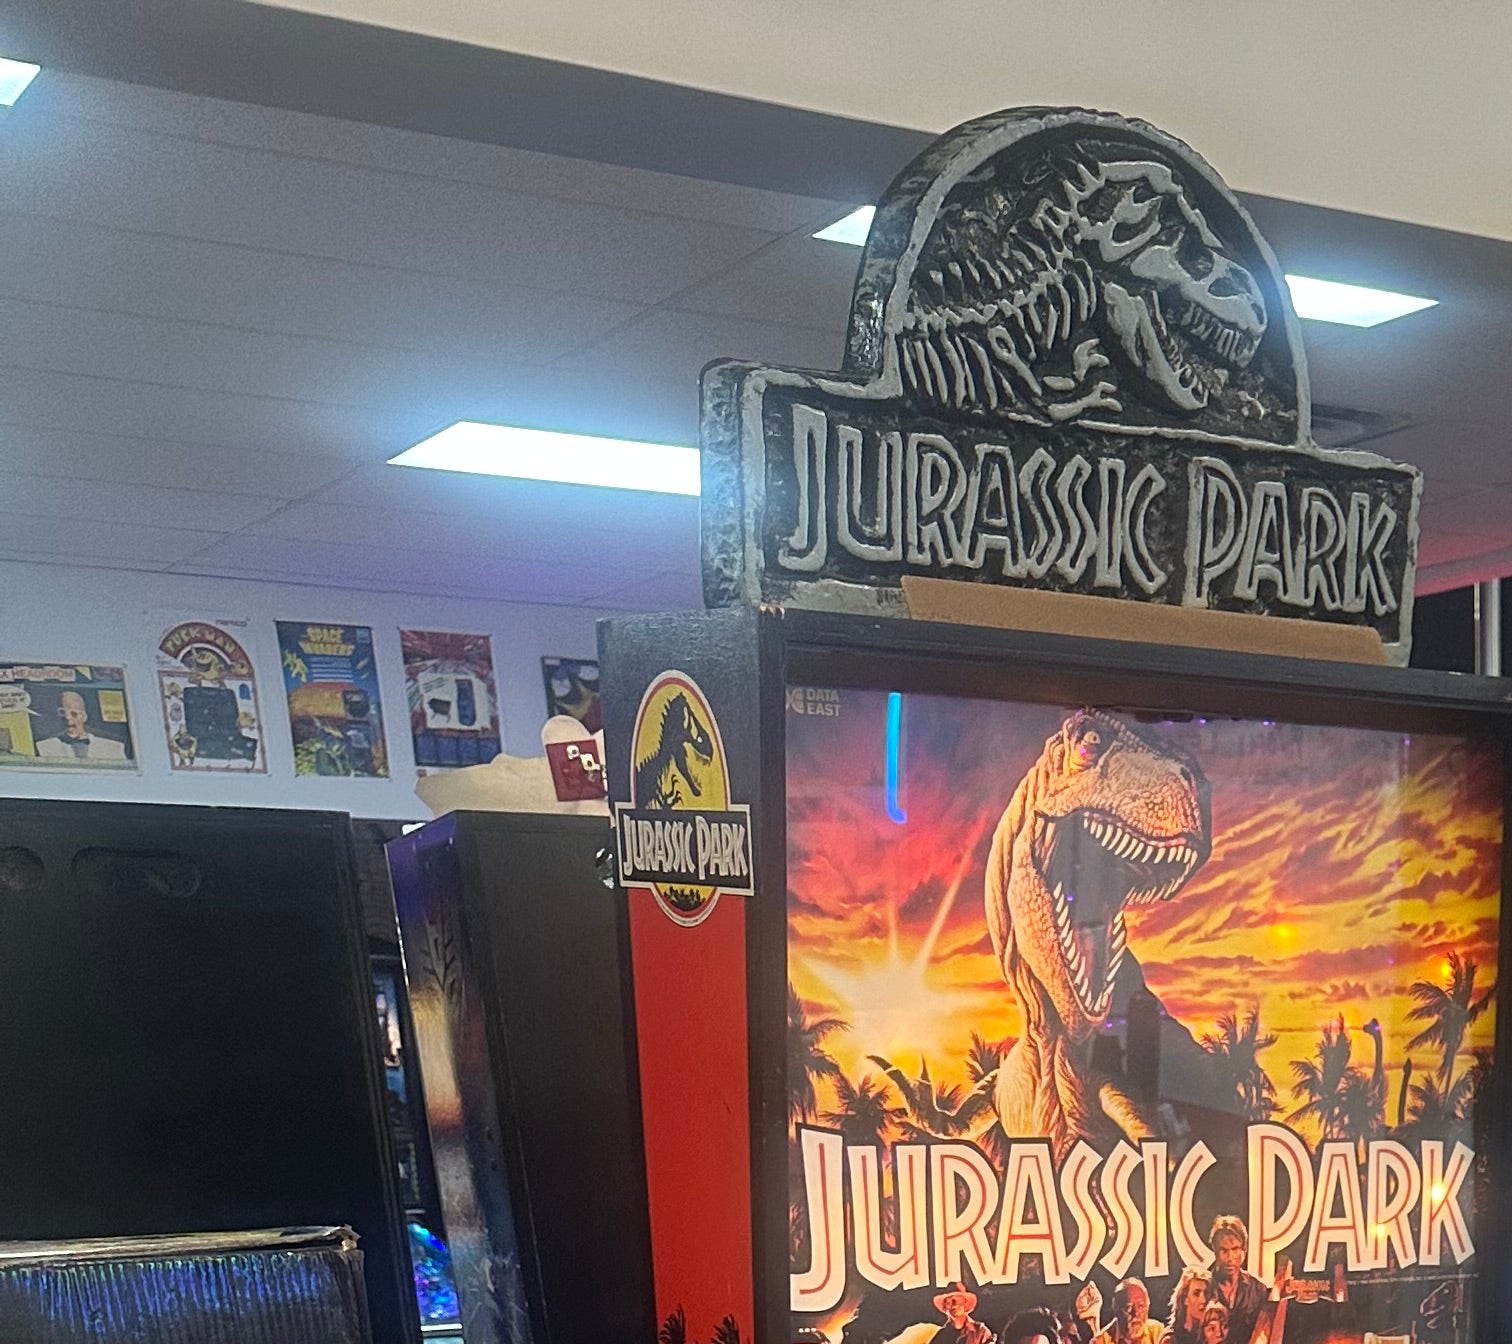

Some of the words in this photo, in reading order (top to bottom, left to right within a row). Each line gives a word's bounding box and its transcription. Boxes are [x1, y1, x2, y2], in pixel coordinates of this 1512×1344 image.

[777, 402, 1170, 594] JURASSIC
[1183, 455, 1399, 619] PARK
[806, 688, 840, 702] DATA
[807, 702, 842, 717] EAST
[622, 814, 696, 877] JURASSIC
[695, 815, 748, 881] PARK
[790, 1122, 1217, 1312] JURASSIC
[1248, 1124, 1476, 1280] PARK
